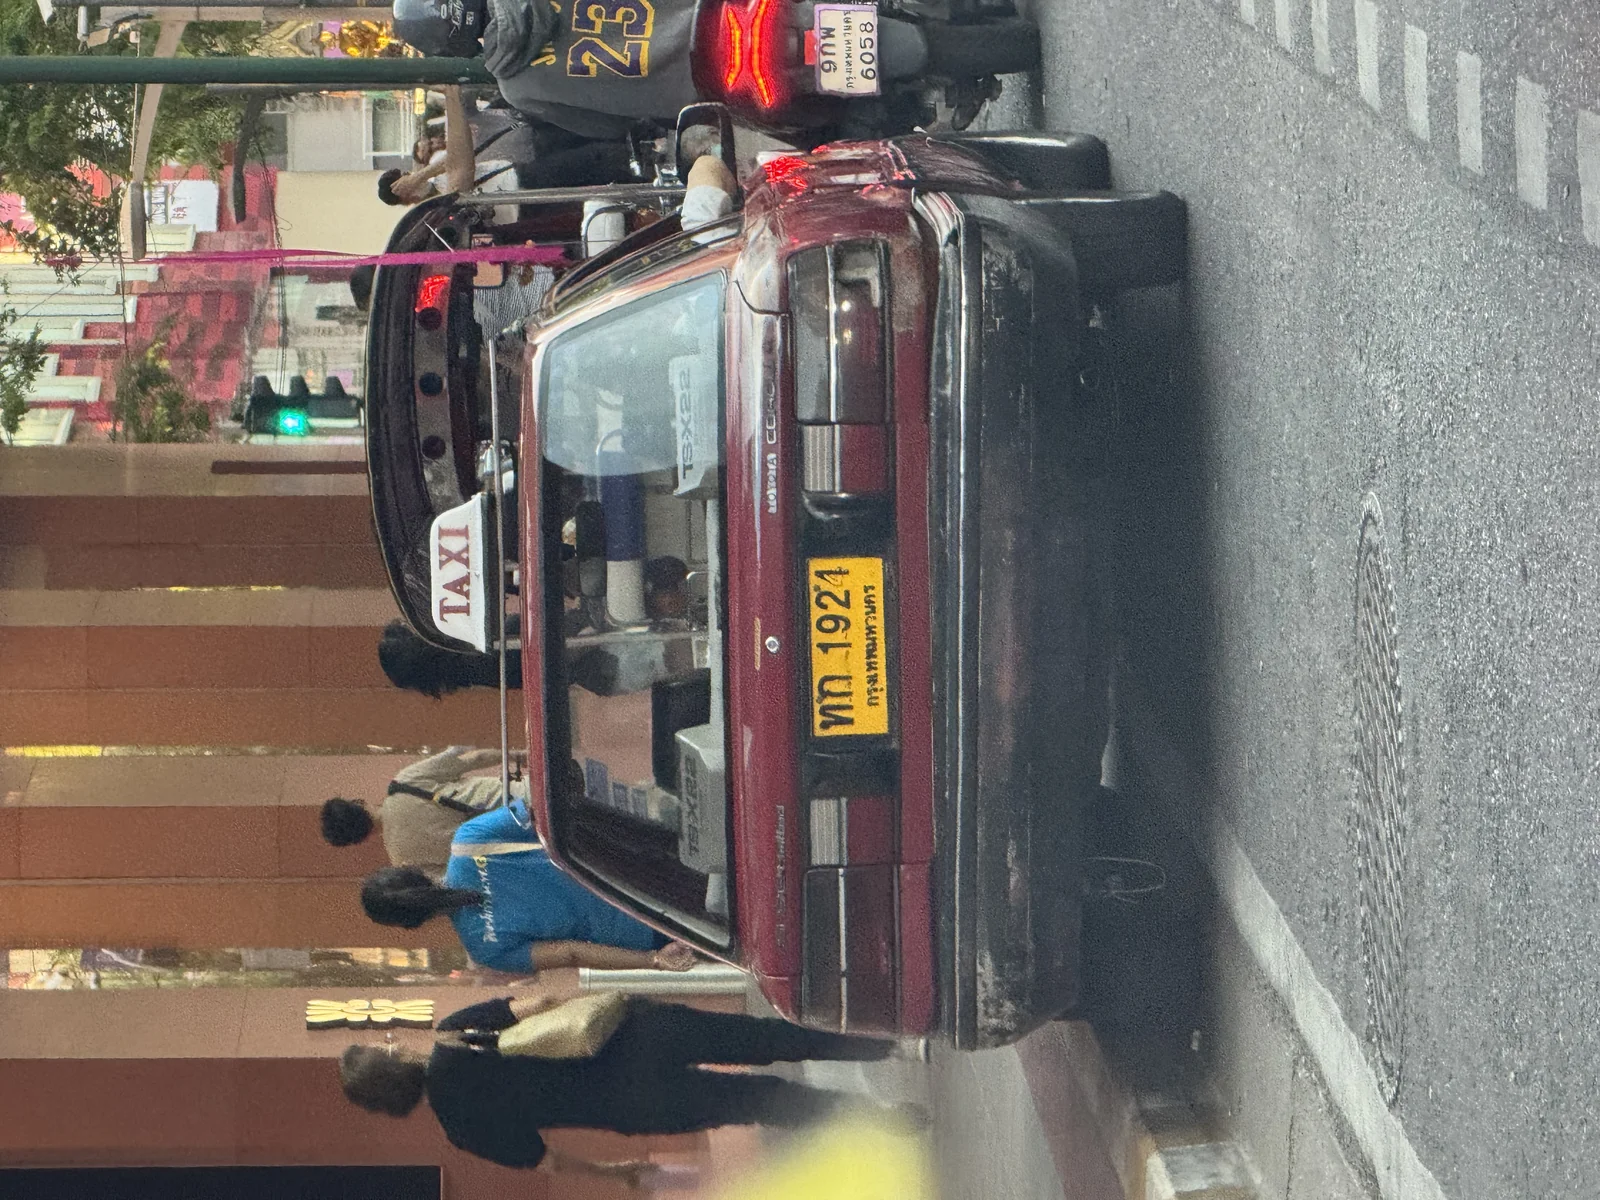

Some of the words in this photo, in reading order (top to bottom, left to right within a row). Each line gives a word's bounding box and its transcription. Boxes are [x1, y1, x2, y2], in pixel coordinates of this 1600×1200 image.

[566, 0, 655, 77] 23
[820, 26, 837, 74] 9กพ
[859, 21, 877, 81] 6058
[438, 524, 470, 623] TAXI
[814, 566, 852, 655] 1924
[862, 584, 884, 707] กรุงเทพมหานคร
[815, 674, 854, 730] ทก
